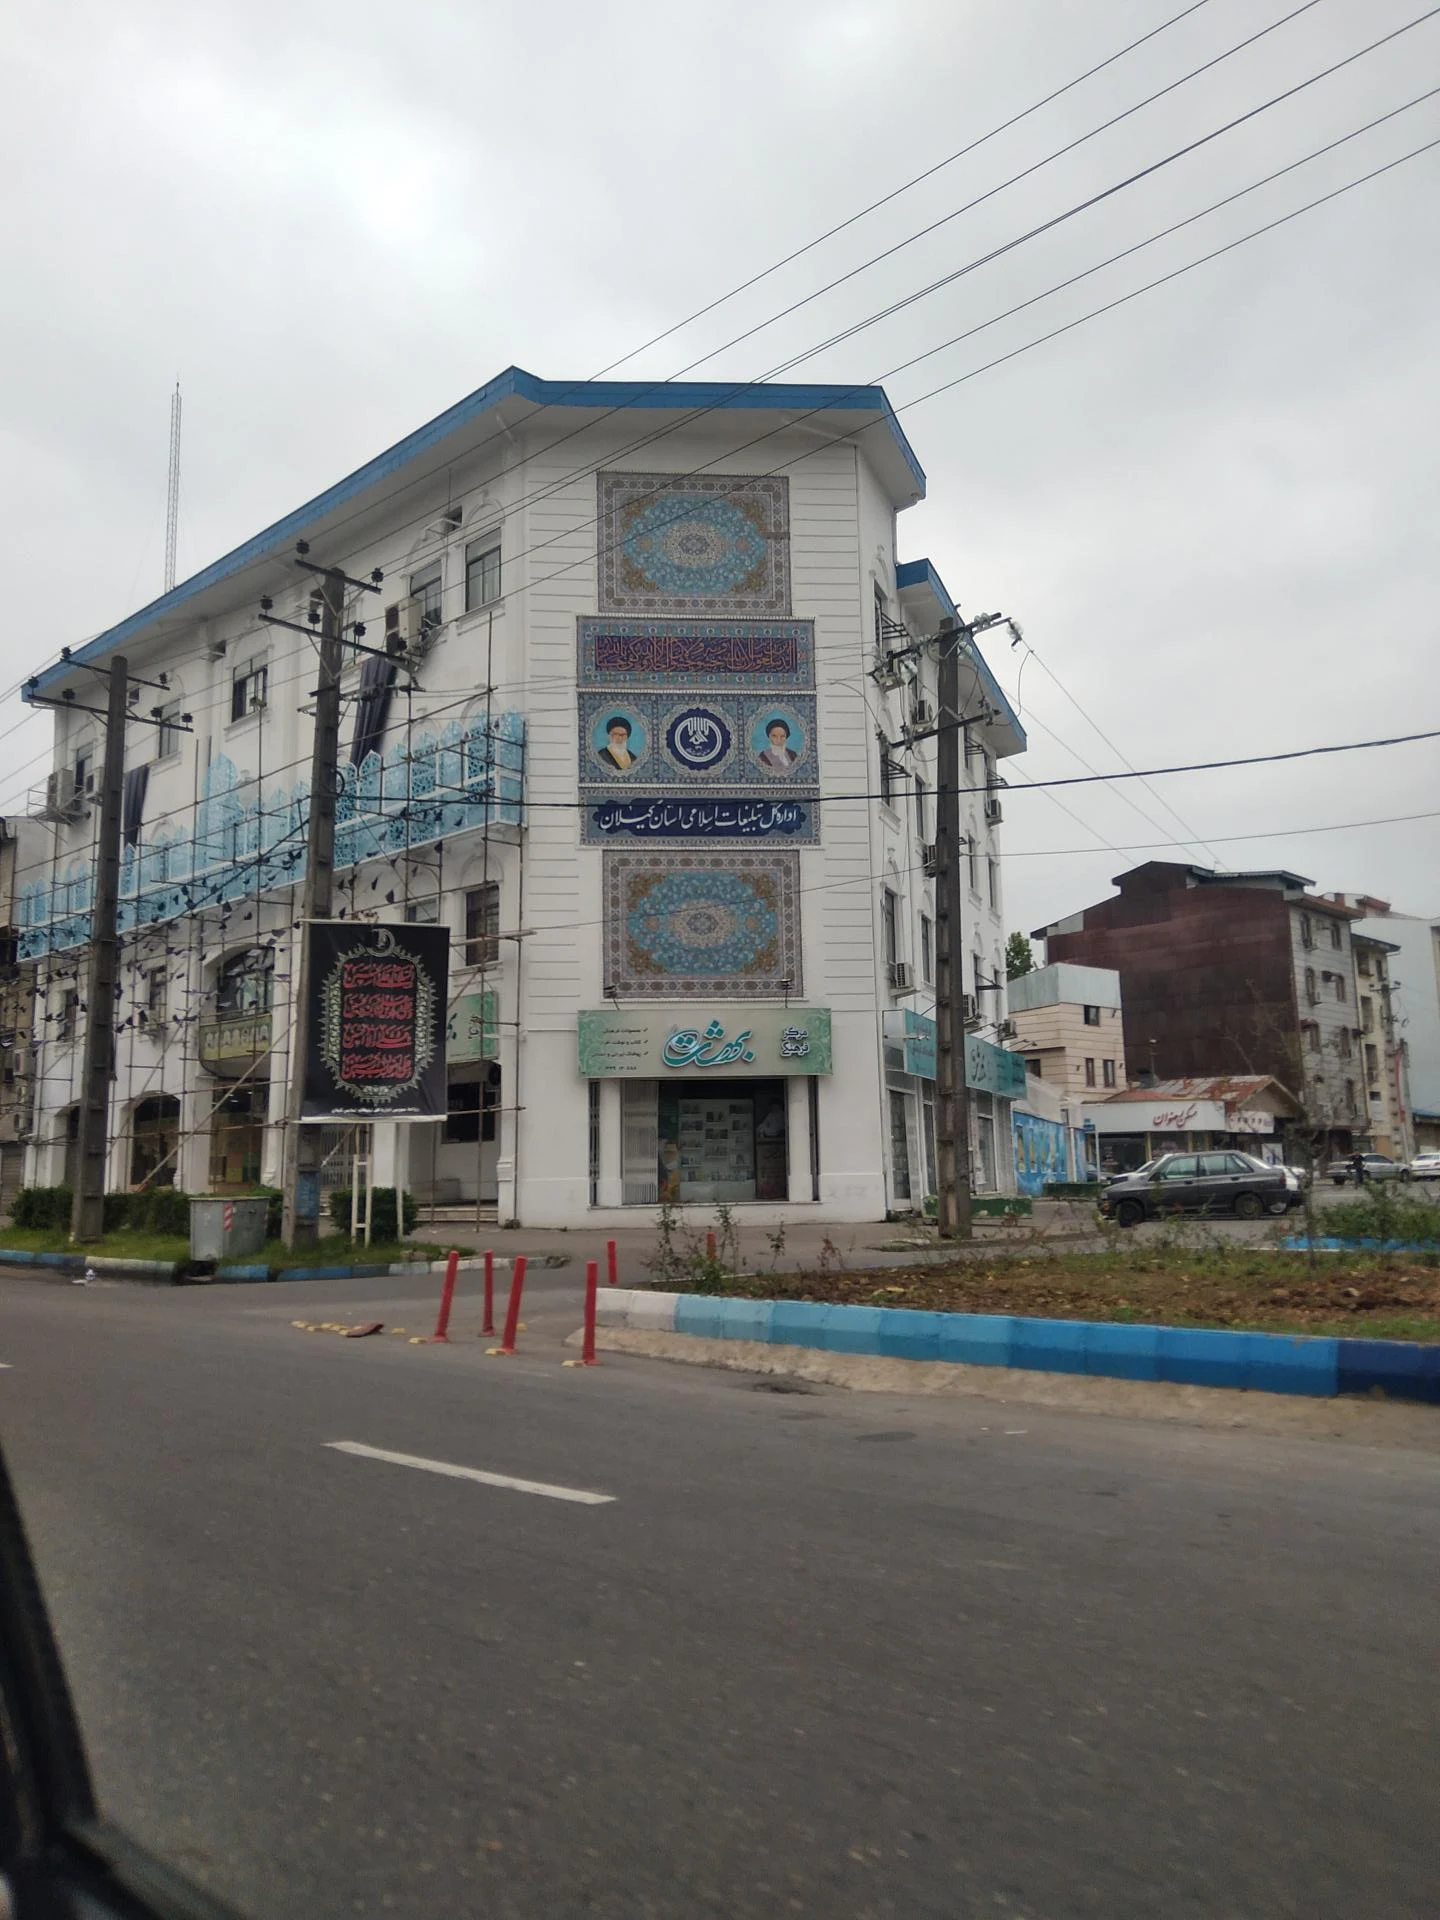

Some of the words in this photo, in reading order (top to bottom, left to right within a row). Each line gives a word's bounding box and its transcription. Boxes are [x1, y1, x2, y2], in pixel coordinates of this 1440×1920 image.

[600, 799, 662, 830] گیلان
[649, 805, 682, 829] استان
[680, 805, 717, 832] اسلامی
[716, 804, 762, 833] تبلیغات
[759, 803, 781, 829] کل
[775, 808, 797, 824] اداره
[662, 1018, 755, 1067] بهشت
[783, 1027, 809, 1040] مرکز
[780, 1040, 810, 1057] فرهنگی
[1152, 1109, 1185, 1127] رضوان
[1176, 1103, 1198, 1128] مسکن
